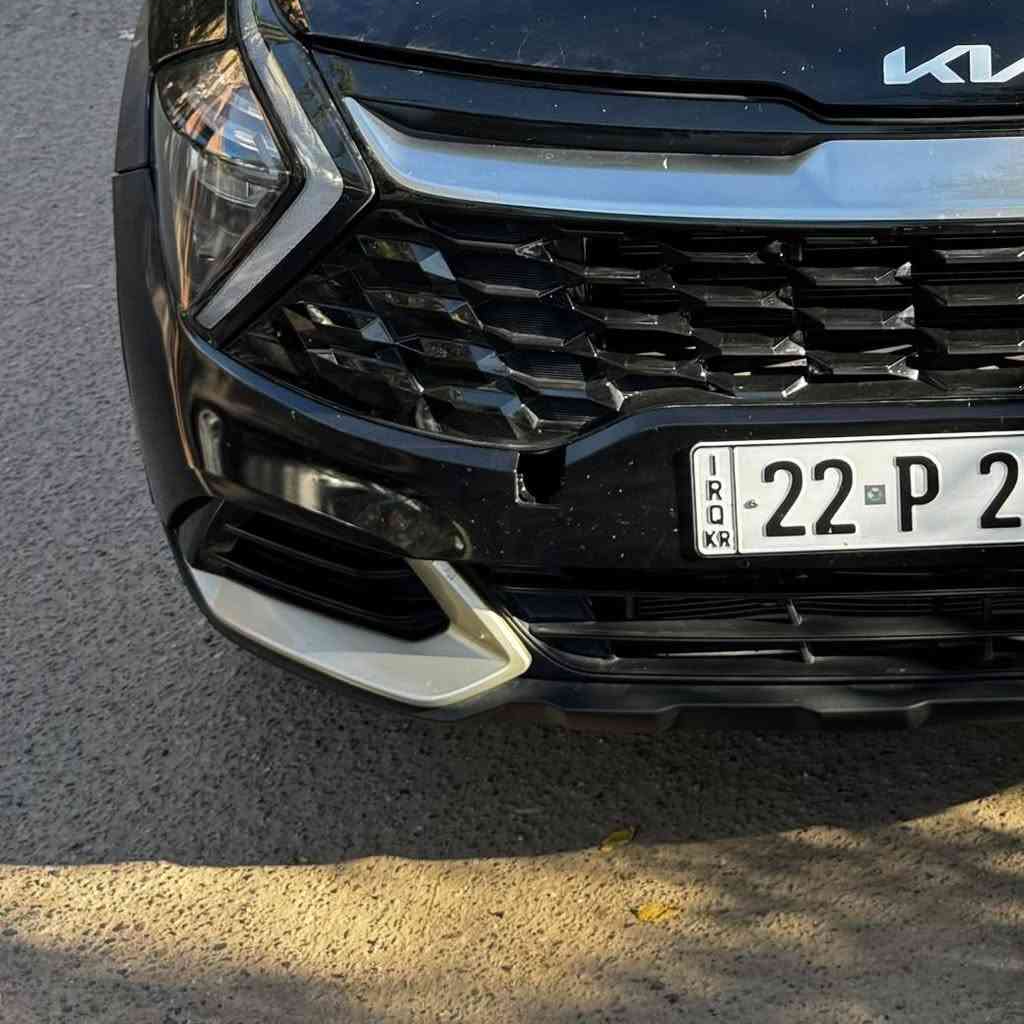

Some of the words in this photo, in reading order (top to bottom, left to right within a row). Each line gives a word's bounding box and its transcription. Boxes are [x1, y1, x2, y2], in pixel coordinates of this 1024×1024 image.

[764, 459, 856, 537] 22
[895, 455, 940, 532] P
[703, 530, 730, 548] KR
